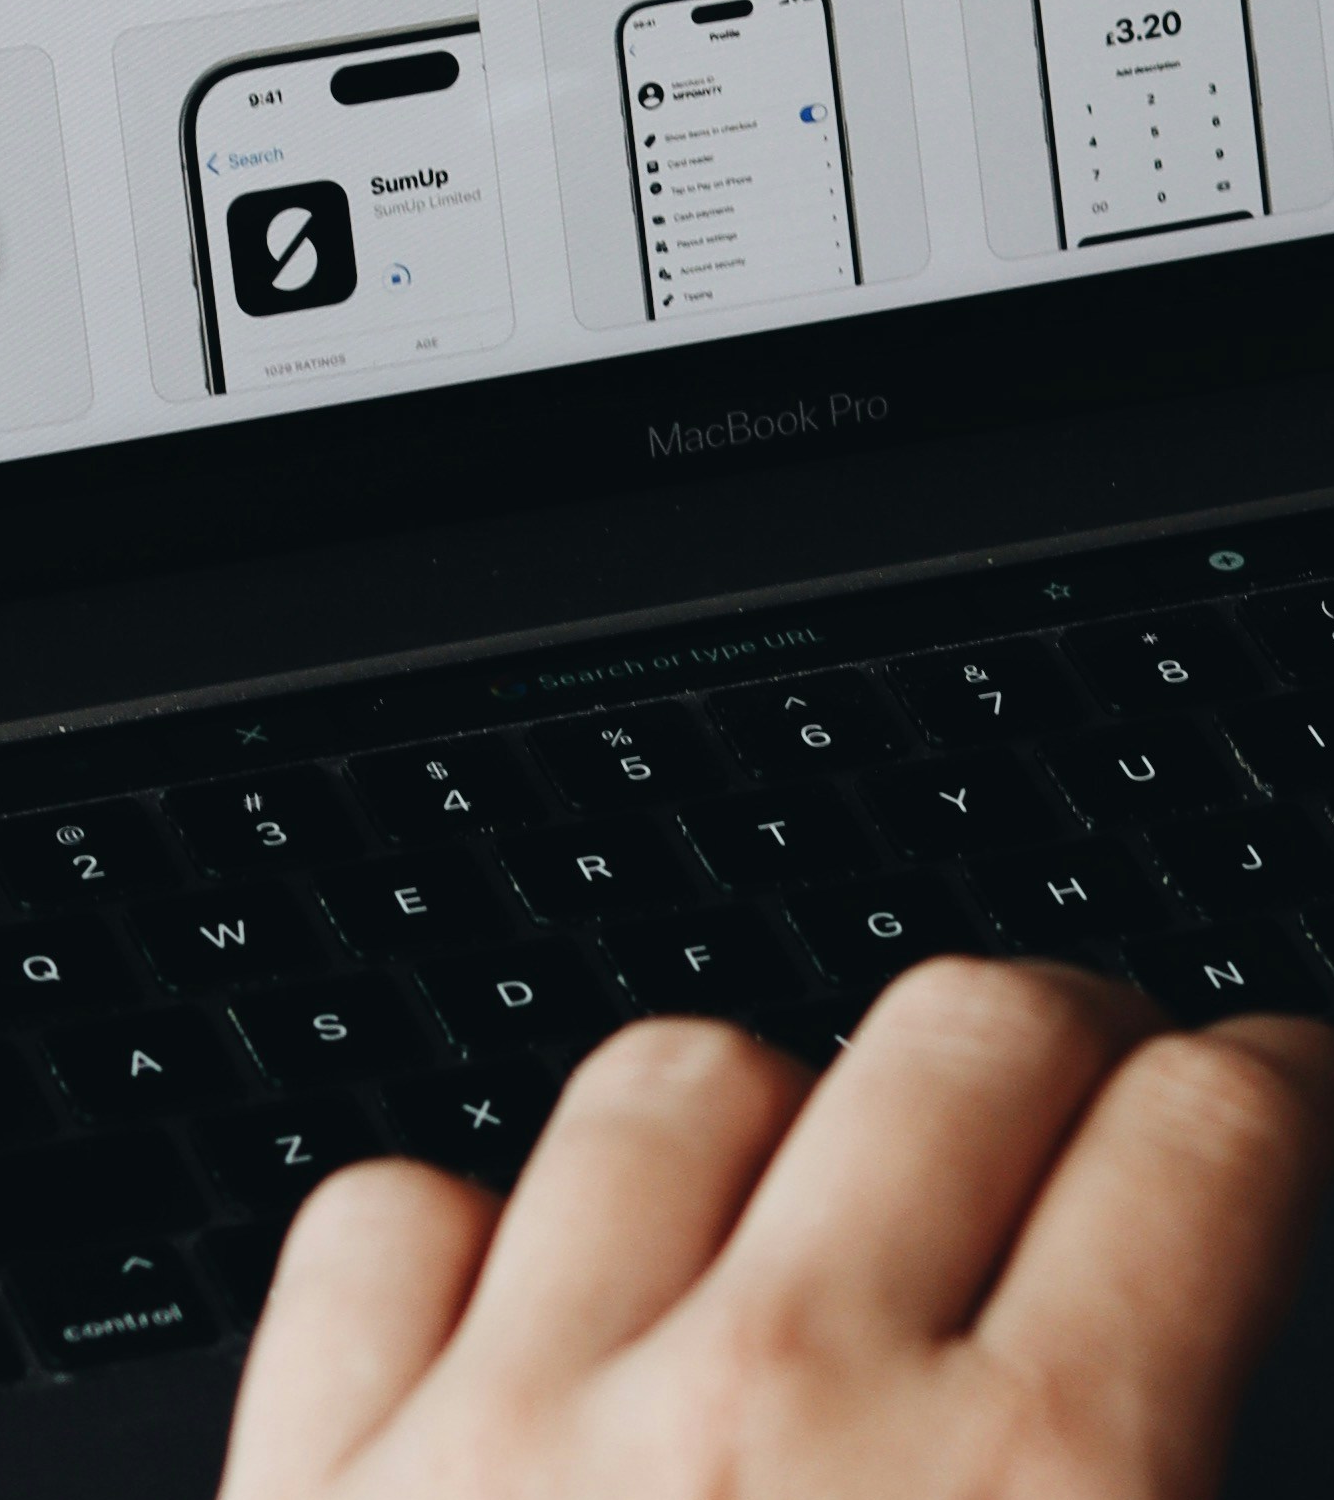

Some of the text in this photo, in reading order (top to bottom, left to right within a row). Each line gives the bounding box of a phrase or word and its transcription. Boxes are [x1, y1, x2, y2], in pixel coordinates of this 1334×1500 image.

[709, 27, 741, 42] Profile
[1107, 11, 1181, 45] £3.20
[249, 90, 282, 107] 9:41
[1147, 93, 1156, 106] 2
[1208, 83, 1218, 96] 3
[1088, 136, 1098, 149] 4
[228, 146, 284, 170] Search
[371, 169, 448, 195] SumUp
[1092, 168, 1101, 181] 7
[373, 189, 482, 218] SumUp Limited
[1091, 200, 1110, 214] 00
[1157, 190, 1167, 203] 0
[295, 354, 347, 373] RATINGS
[647, 391, 889, 459] MacBook Pro
[537, 628, 825, 691] Search or type URL
[1158, 660, 1188, 682] 8
[979, 692, 1001, 714] 7
[801, 725, 831, 747] 6
[621, 756, 651, 779] 5
[1119, 756, 1155, 781] U
[444, 790, 469, 811] 4
[940, 788, 966, 812] Y
[257, 822, 286, 845] 3
[758, 821, 785, 845] T
[73, 855, 103, 879] 2
[577, 856, 612, 881] R
[1242, 845, 1262, 869] J
[395, 888, 426, 913] E
[1048, 878, 1087, 904] H
[200, 920, 245, 948] W
[868, 913, 902, 937] G
[23, 956, 59, 981] Q
[685, 946, 709, 971] F
[1204, 961, 1244, 988] N
[497, 981, 532, 1006] D
[313, 1015, 347, 1040] S
[131, 1050, 162, 1076] A
[462, 1099, 501, 1129] X
[277, 1136, 310, 1164] Z
[64, 1304, 182, 1341] control
